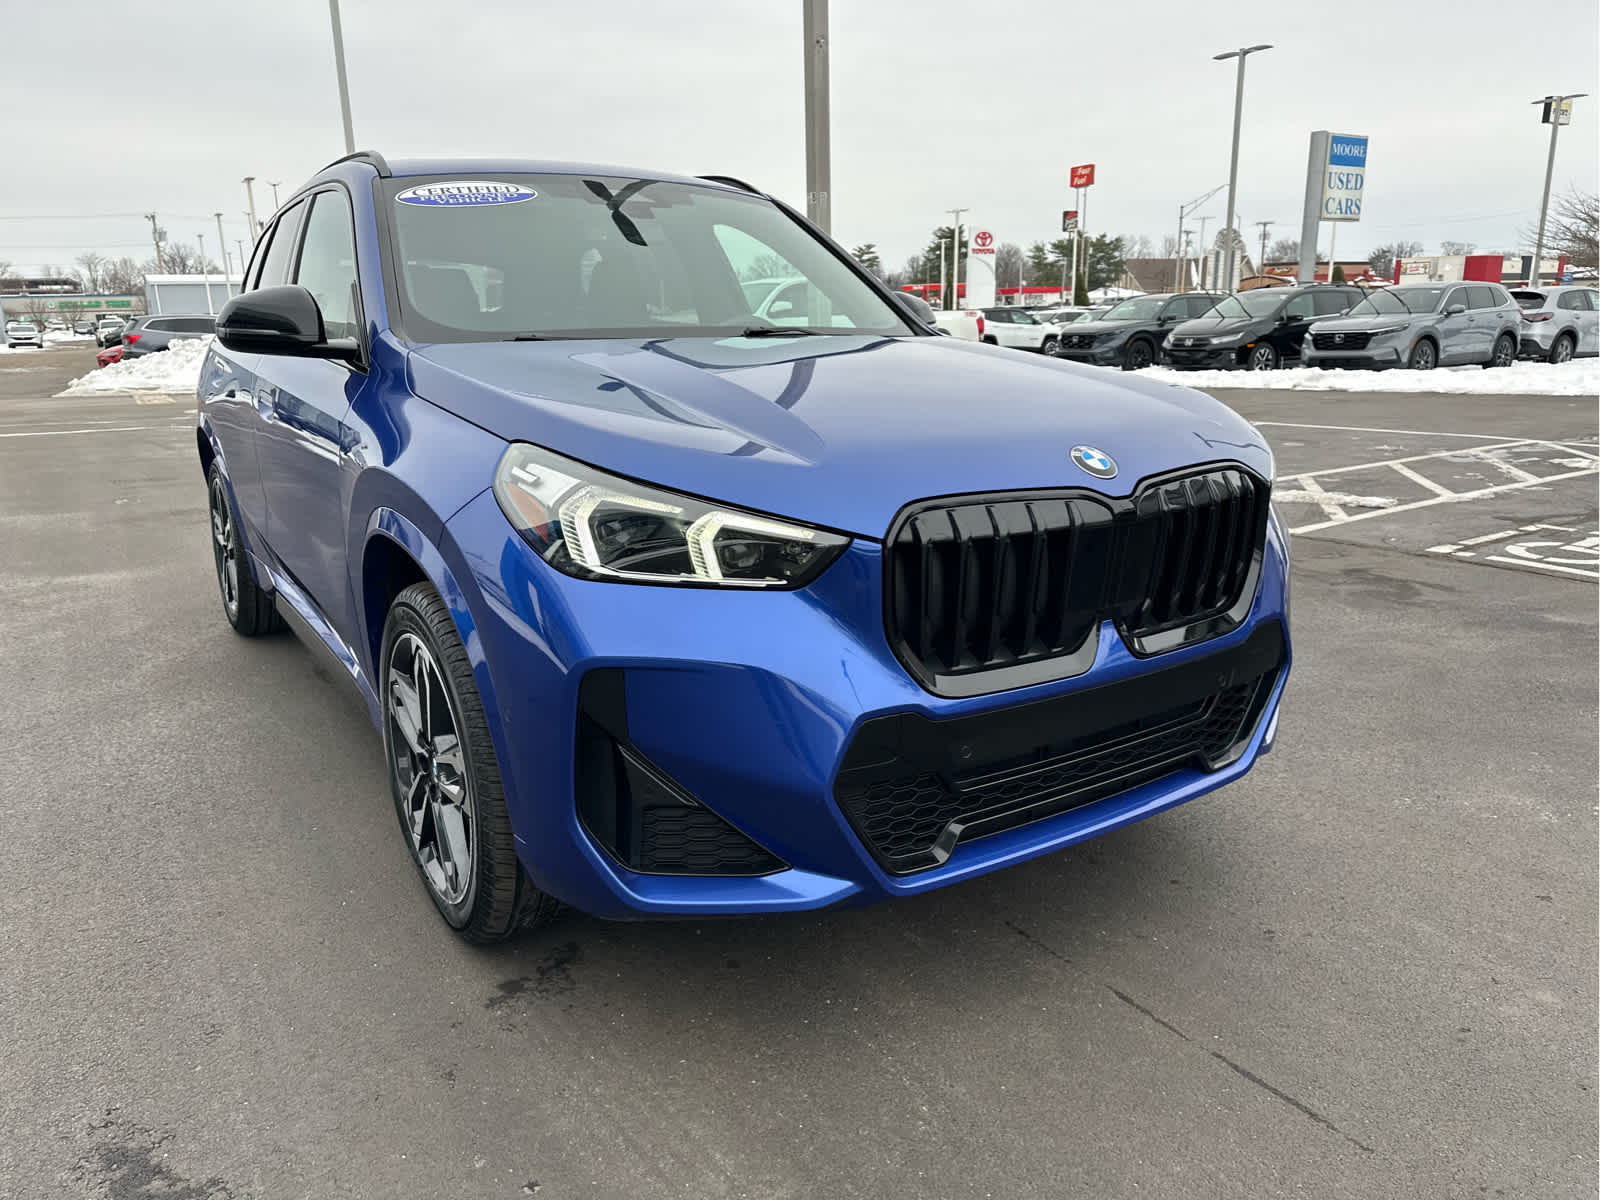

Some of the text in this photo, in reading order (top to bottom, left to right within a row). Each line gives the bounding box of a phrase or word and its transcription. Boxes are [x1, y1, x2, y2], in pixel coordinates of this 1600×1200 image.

[1332, 143, 1365, 158] MOORE
[1328, 171, 1364, 191] USED
[412, 186, 520, 196] CERTIFIED
[1325, 197, 1361, 216] CARS
